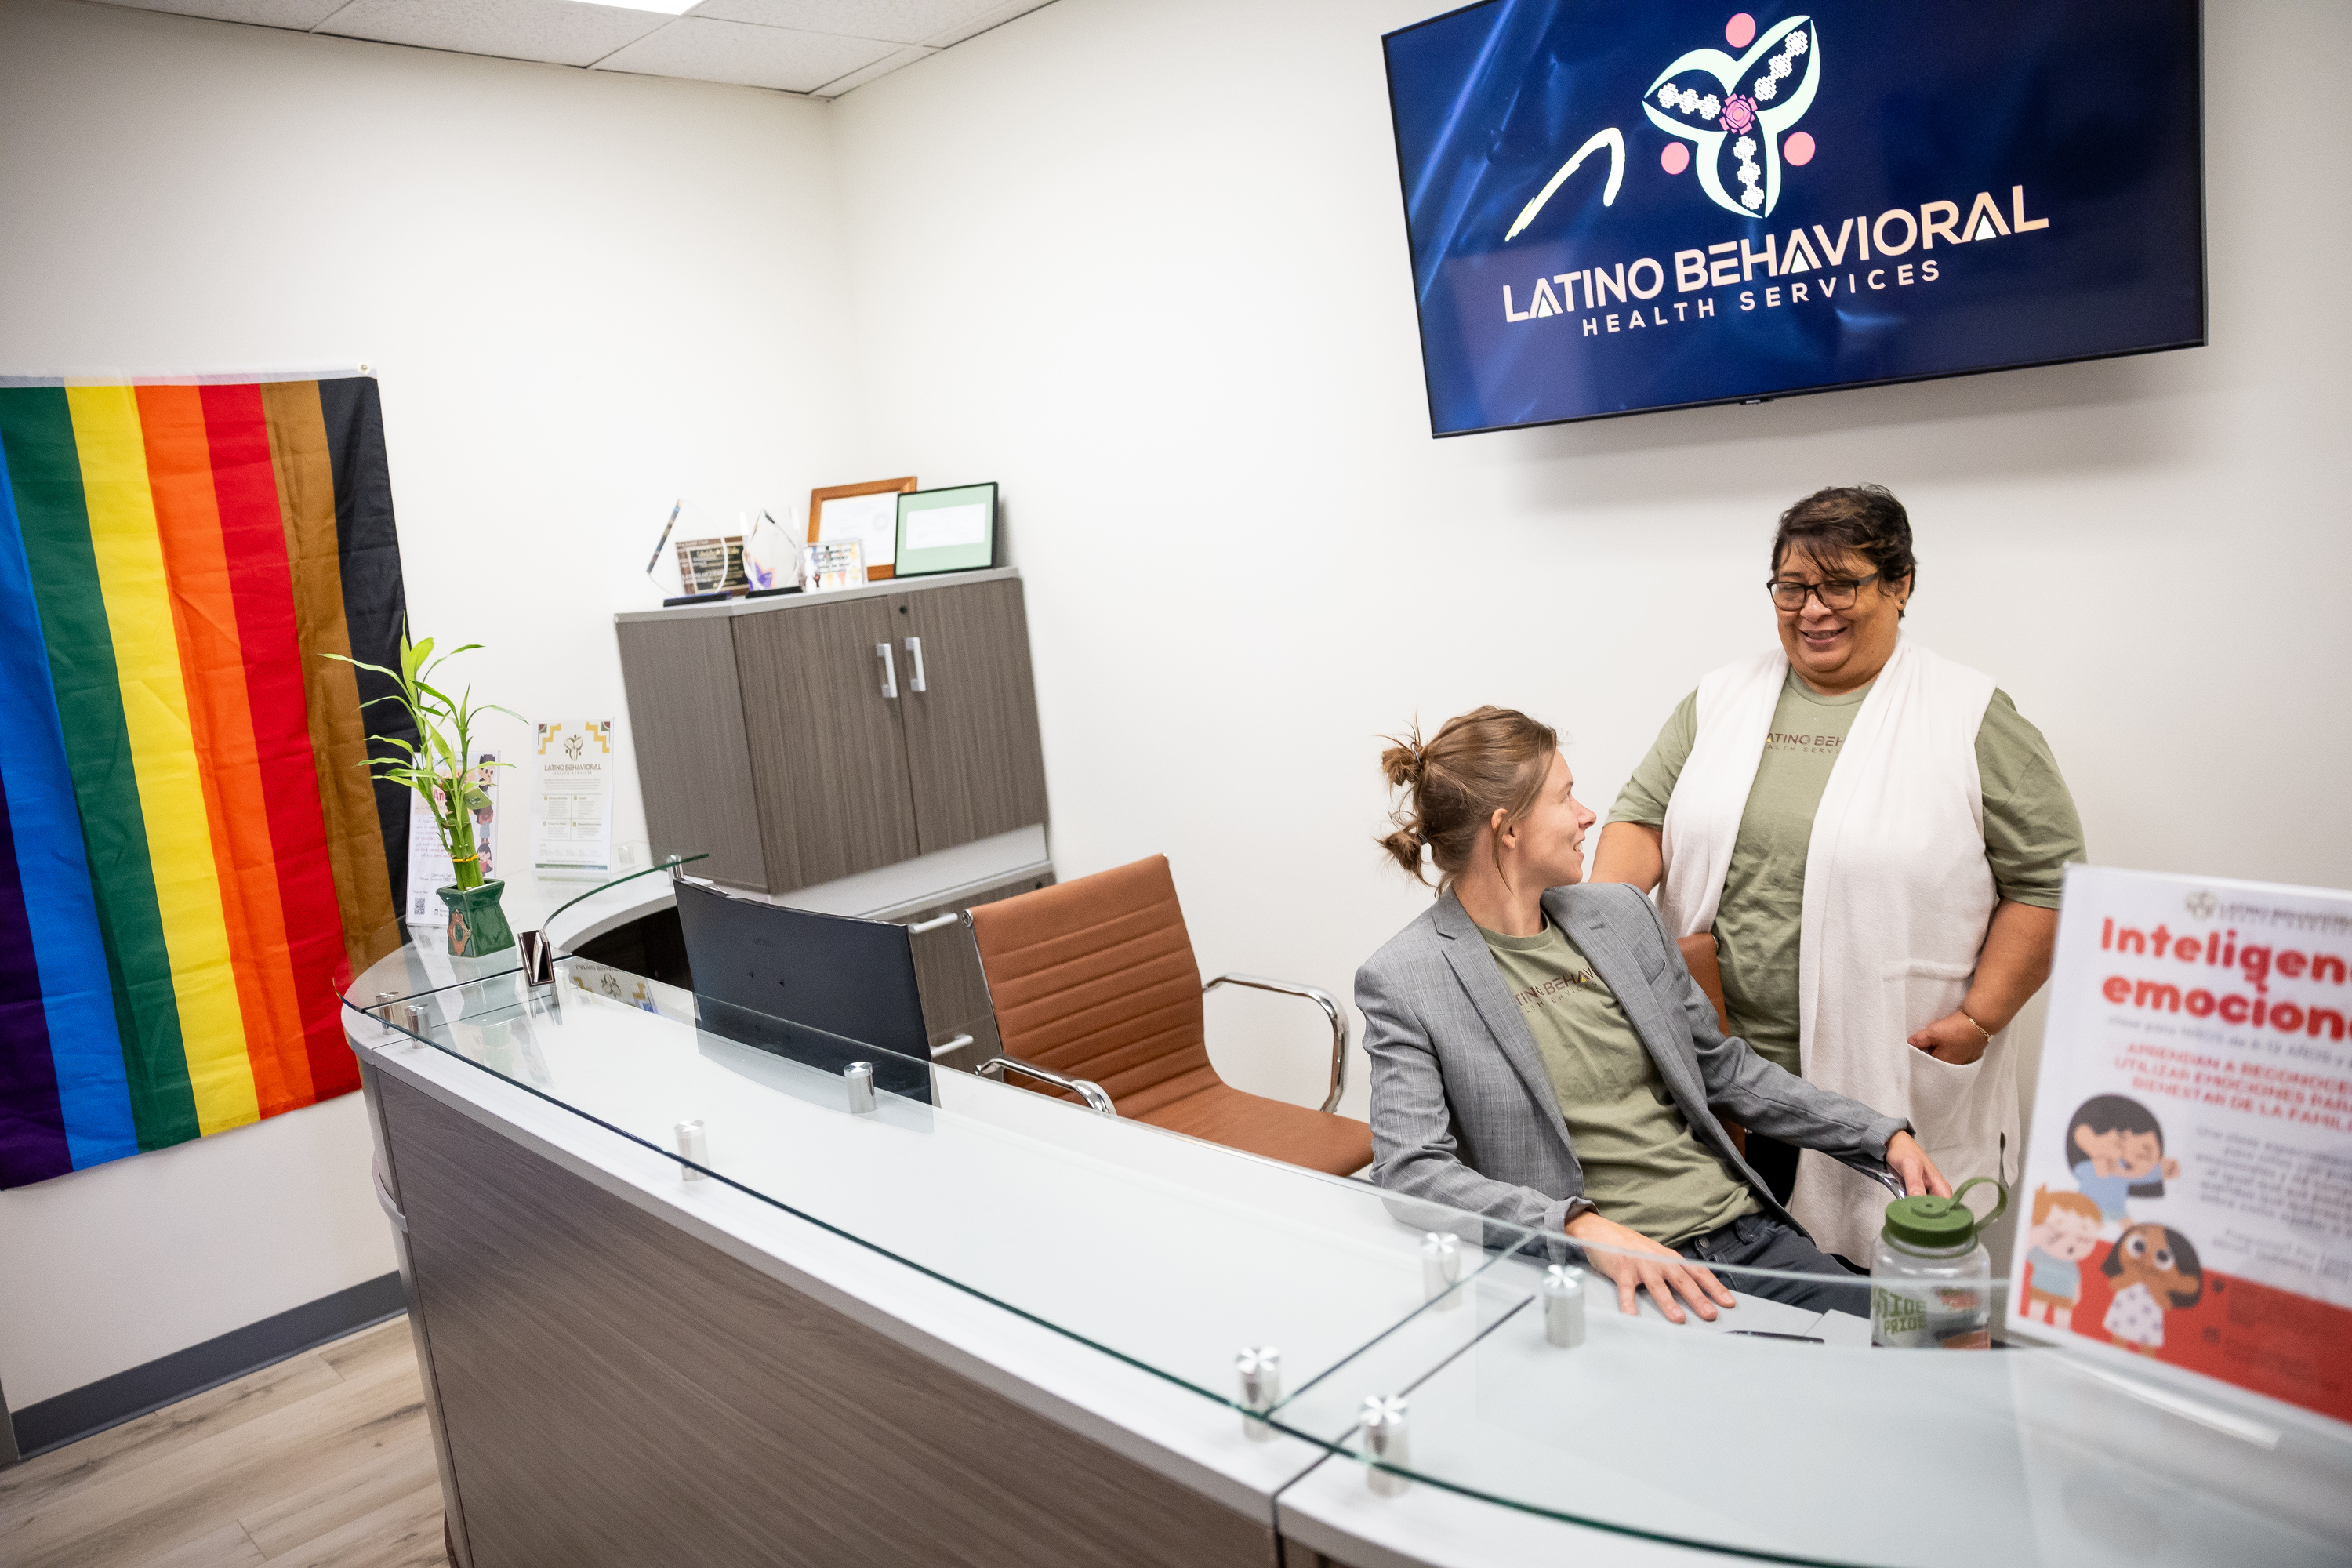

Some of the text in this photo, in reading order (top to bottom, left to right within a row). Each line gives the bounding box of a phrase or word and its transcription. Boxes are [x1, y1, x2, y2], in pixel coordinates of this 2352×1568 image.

[1504, 185, 2049, 323] LATINO BEHAVIORAL
[1582, 260, 1942, 337] HEALTH SERVICES
[565, 763, 602, 771] BEHAVIORAL
[2100, 916, 2352, 986] Inteligen
[2102, 975, 2352, 1042] emocion
[2310, 1089, 2352, 1114] PAR
